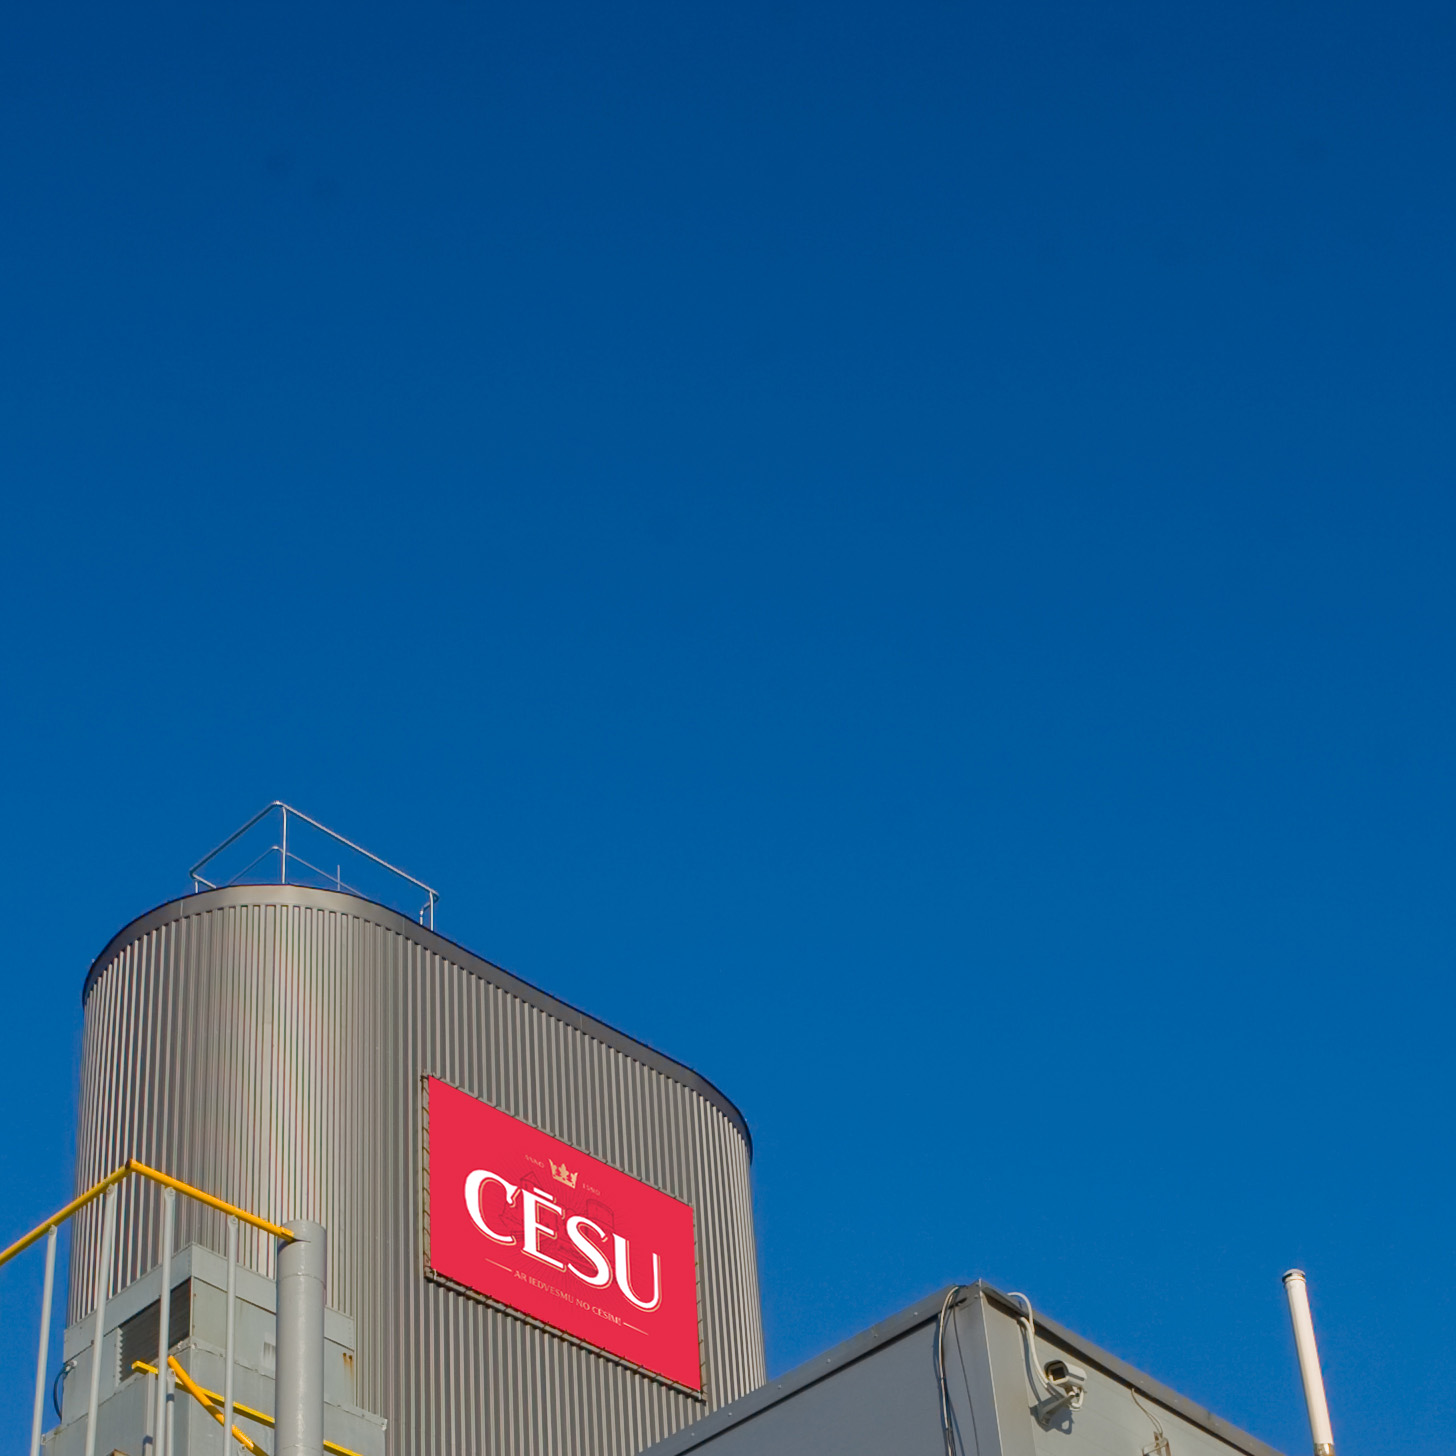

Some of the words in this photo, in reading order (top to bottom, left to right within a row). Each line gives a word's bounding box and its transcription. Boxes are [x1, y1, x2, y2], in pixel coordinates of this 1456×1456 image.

[465, 1169, 662, 1312] CĒSU
[514, 1270, 527, 1282] AR
[529, 1276, 573, 1304] IEDVESMU
[575, 1298, 590, 1311] NO
